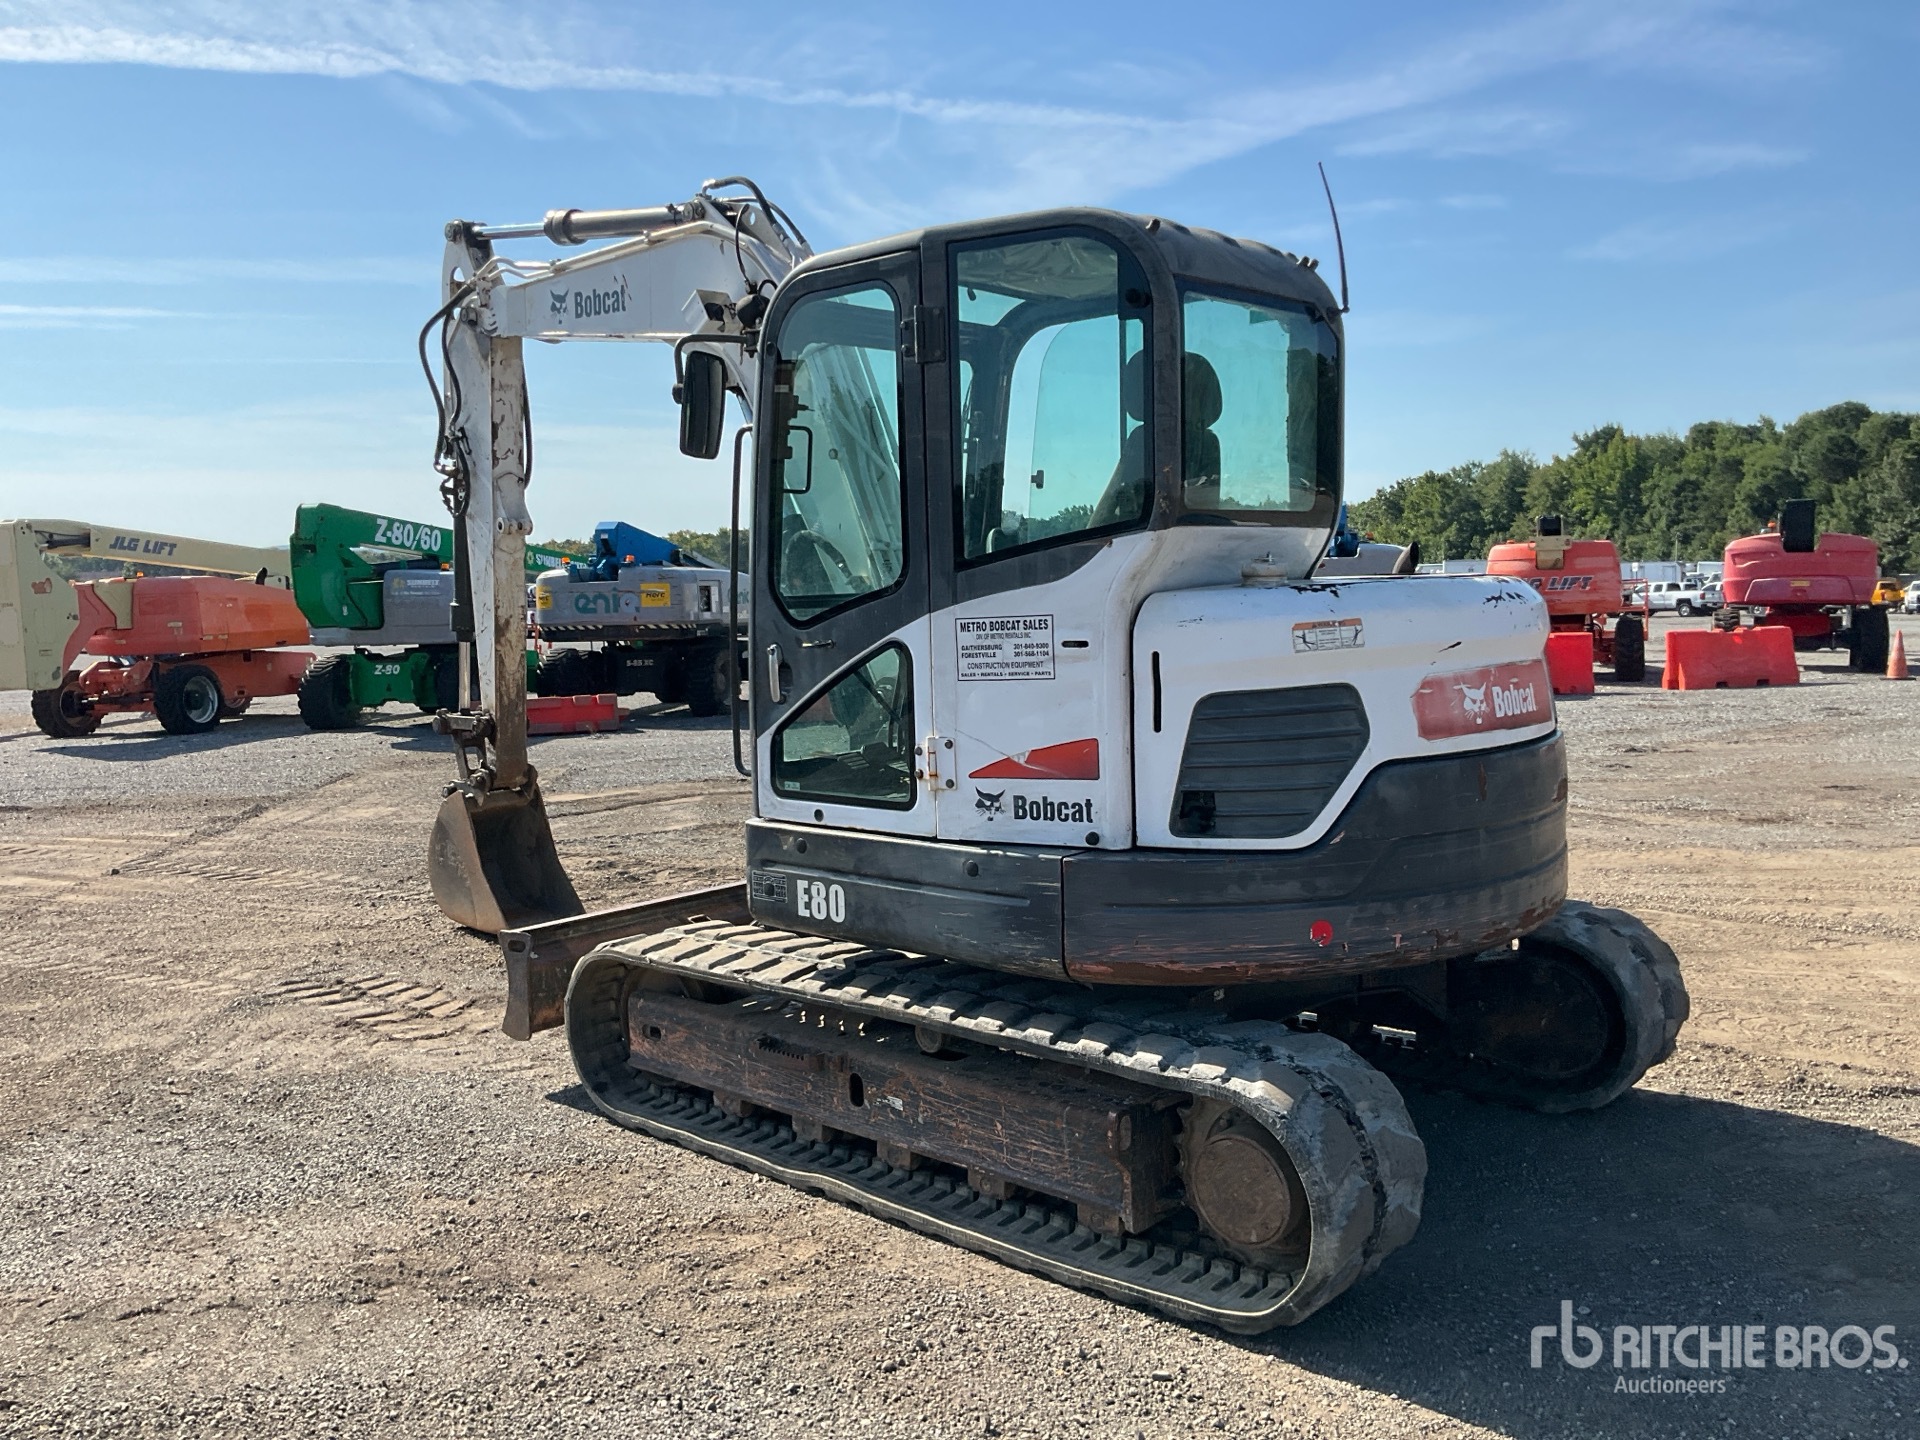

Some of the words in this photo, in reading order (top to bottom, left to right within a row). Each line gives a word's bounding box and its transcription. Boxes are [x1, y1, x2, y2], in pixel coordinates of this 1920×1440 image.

[574, 284, 628, 320] Bobcat
[374, 518, 442, 552] Z-80/60
[109, 535, 141, 552] JLG
[143, 539, 178, 556] LIFT
[1545, 575, 1594, 592] LIFT
[960, 621, 987, 633] METRO
[989, 620, 1021, 632] BOBCAT
[1023, 618, 1049, 631] SALES
[990, 632, 1005, 640] METRO
[961, 651, 997, 659] FORESTVILLE
[374, 664, 401, 675] Z-80
[967, 661, 1010, 670] CONSTRUCTION
[1011, 660, 1044, 669] EQUIPMENT
[1491, 682, 1538, 718] Bobcat
[1012, 795, 1094, 824] Bobcat
[796, 879, 846, 923] E80
